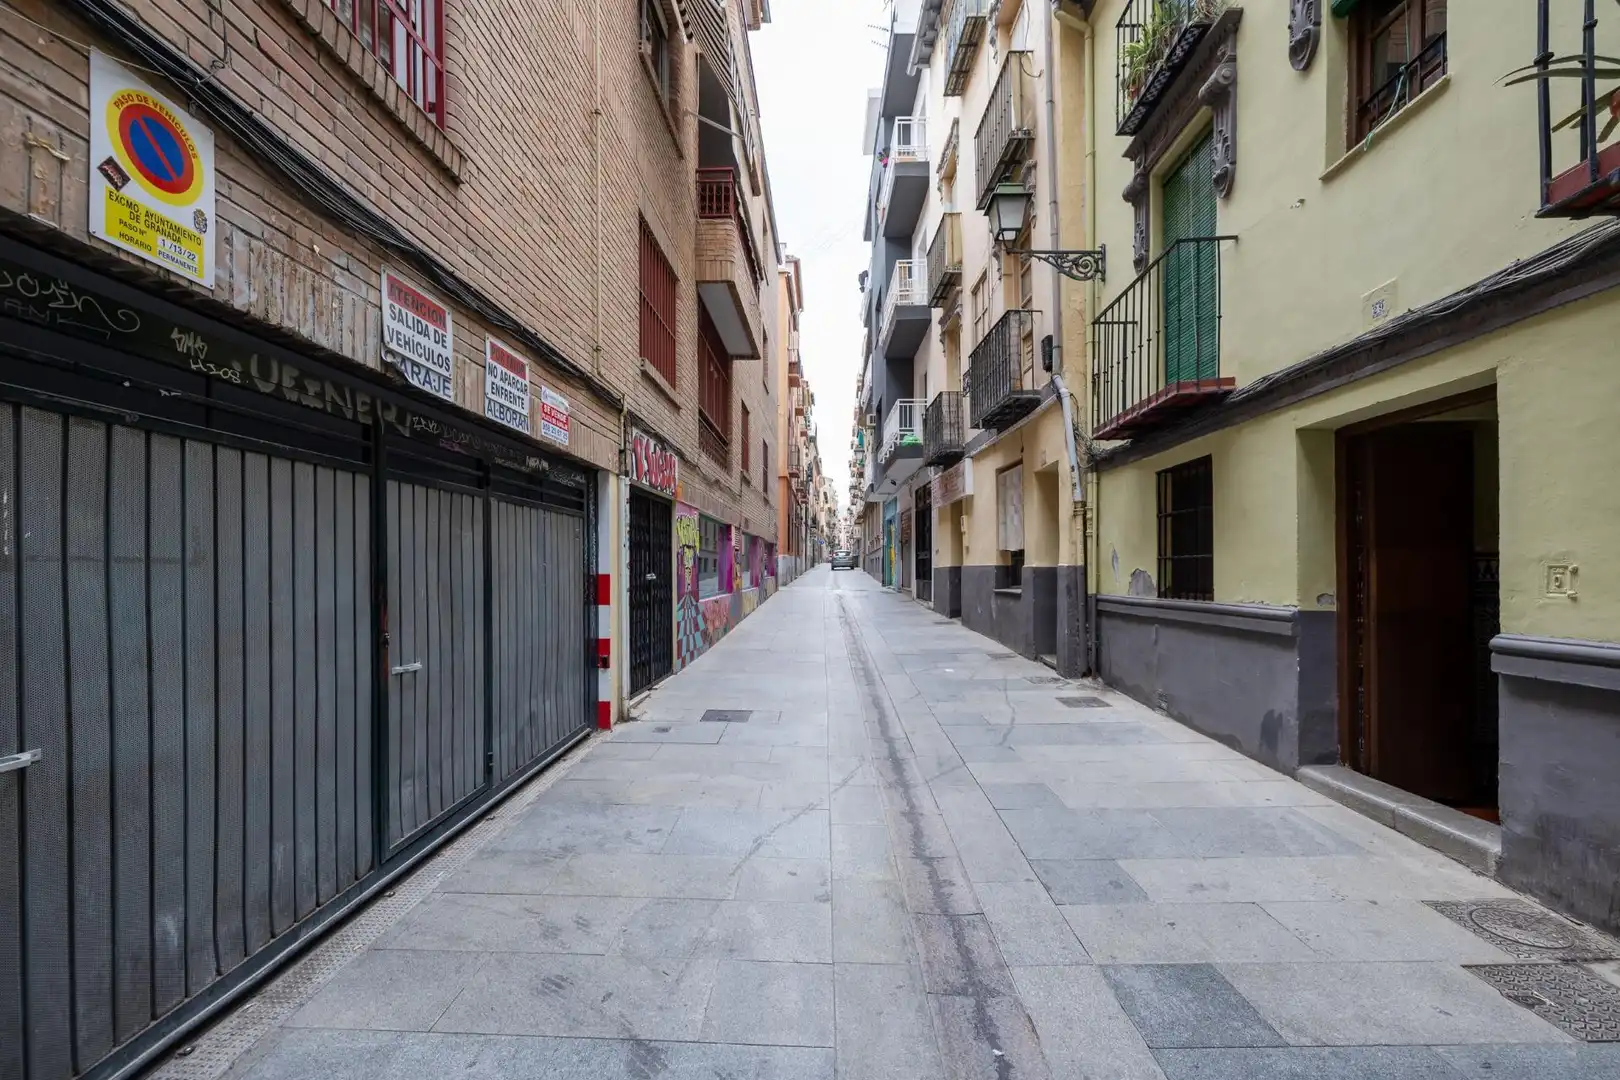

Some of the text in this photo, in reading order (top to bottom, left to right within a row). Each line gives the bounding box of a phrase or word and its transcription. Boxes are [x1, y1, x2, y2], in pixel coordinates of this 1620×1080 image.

[113, 93, 134, 109] PASO
[136, 94, 149, 105] DE
[109, 190, 202, 246] EXCMO. AYUNTAMIENTO
[119, 218, 138, 233] PASO
[129, 211, 183, 244] DE GRANADA
[119, 231, 199, 274] HORARIO PERMANENTE
[389, 303, 448, 350] SALIDA DE
[386, 325, 451, 373] VEHÍCULOS
[487, 362, 528, 396] NO APARCAR
[491, 382, 525, 410] ENFRENTE
[487, 401, 529, 432] ALBORAN
[543, 403, 567, 424] SE VENDE
